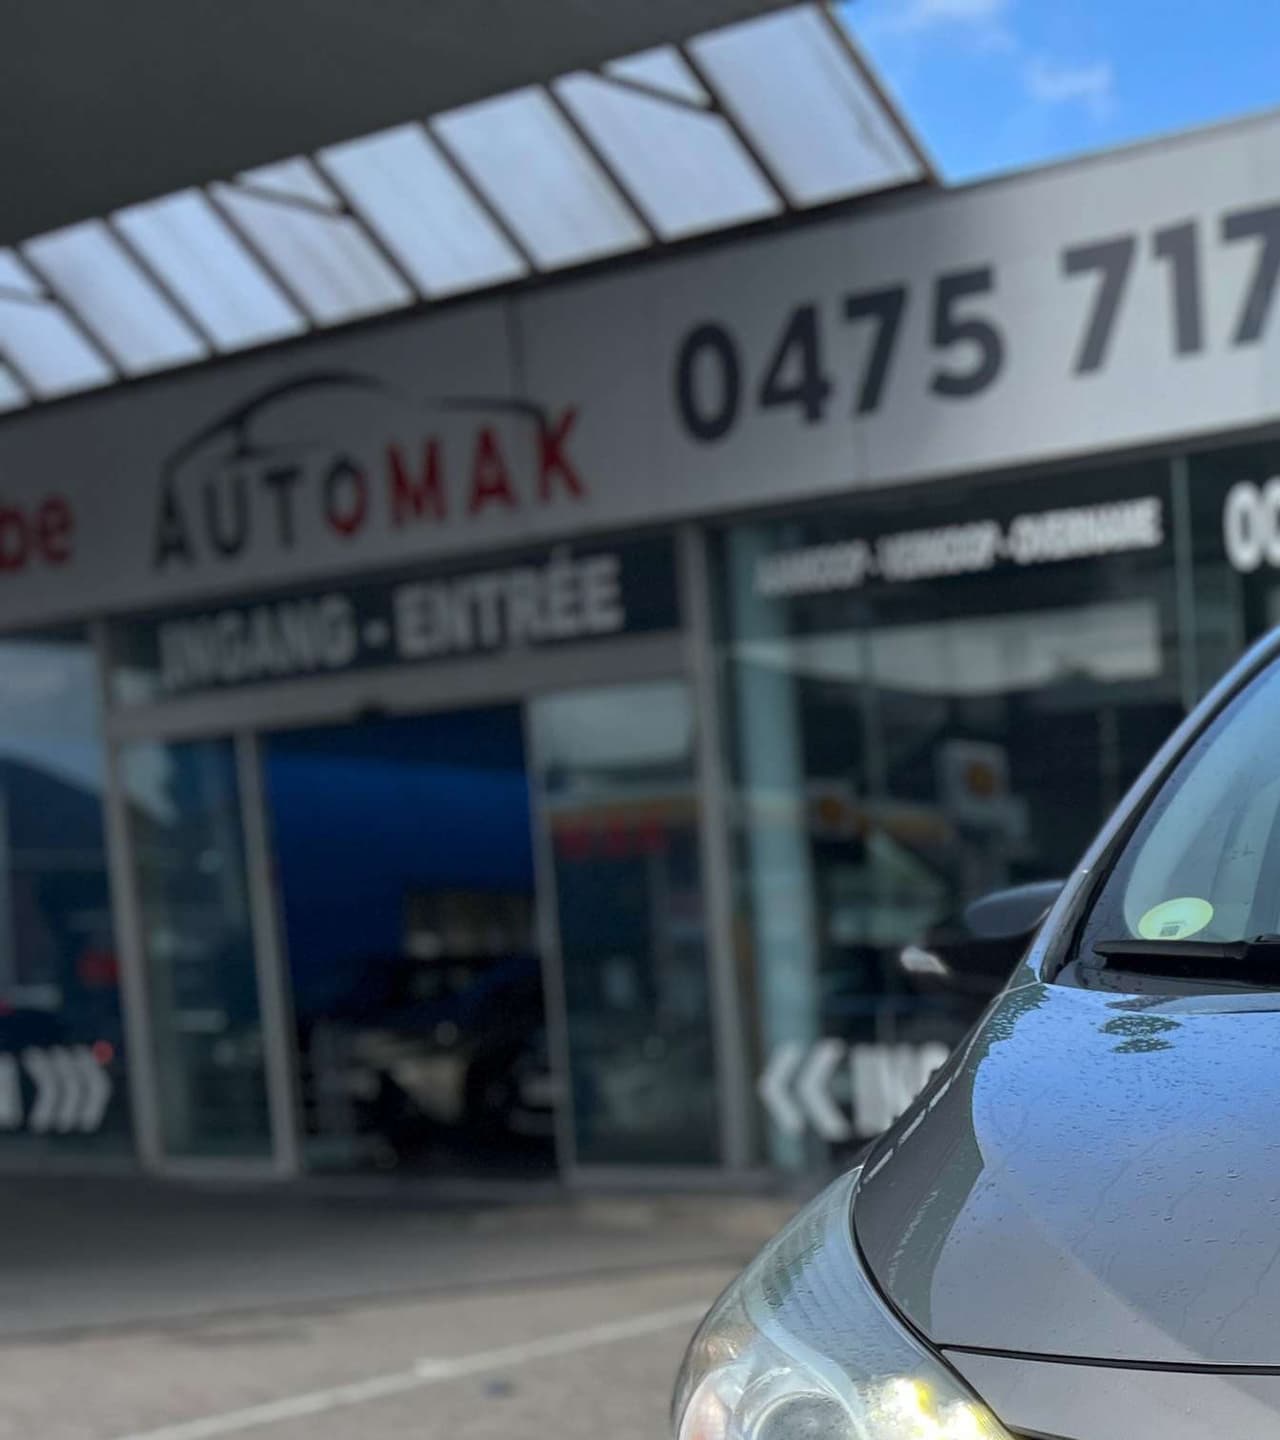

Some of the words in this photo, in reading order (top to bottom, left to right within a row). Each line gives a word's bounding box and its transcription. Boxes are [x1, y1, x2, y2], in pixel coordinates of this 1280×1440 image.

[672, 265, 1008, 444] 0475
[153, 408, 586, 572] AUTOMAK
[158, 594, 358, 689] INGANG
[393, 545, 627, 660] ENTRÉE
